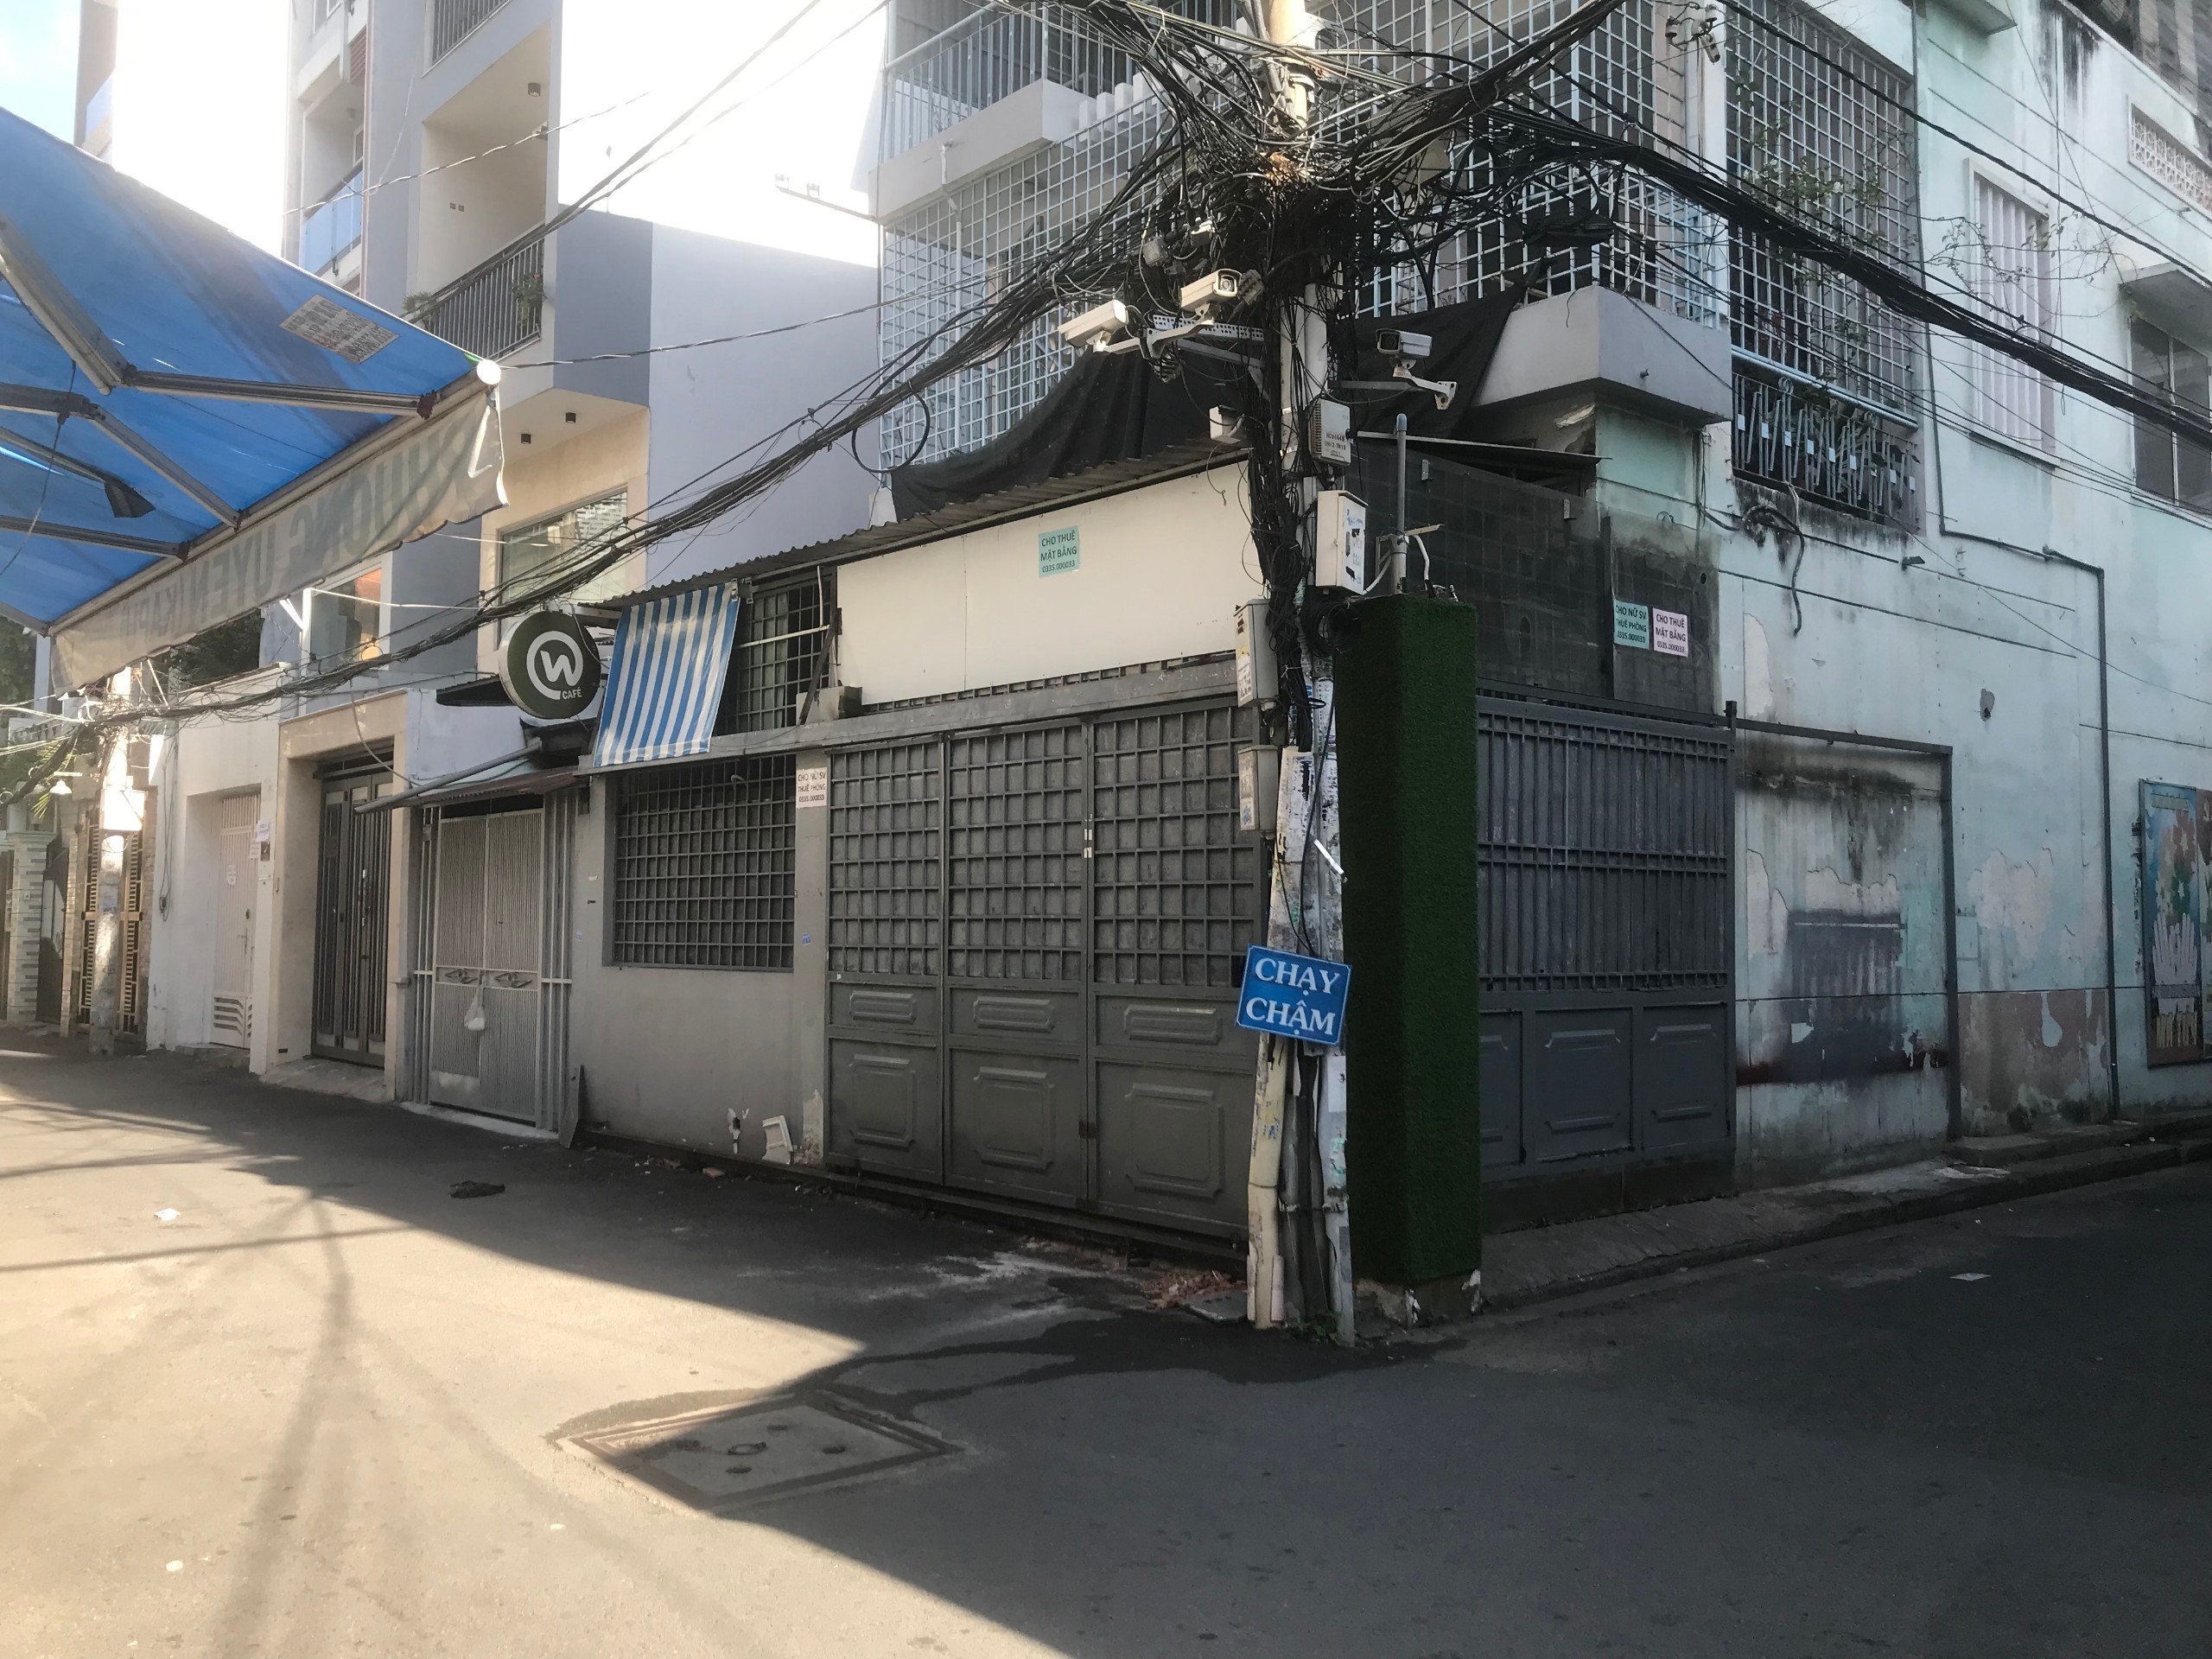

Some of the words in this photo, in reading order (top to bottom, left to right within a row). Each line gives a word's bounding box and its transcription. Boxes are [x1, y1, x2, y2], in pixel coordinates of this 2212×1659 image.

[1041, 536, 1056, 546] CHO
[1057, 530, 1075, 543] THUÊ
[1040, 549, 1056, 562] MẶT
[1615, 605, 1627, 616] CHO
[1638, 610, 1647, 620] SV
[1615, 618, 1628, 628] THUÊ
[1656, 613, 1668, 624] CHO
[1669, 617, 1685, 628] THUÊ
[562, 686, 583, 700] CAFÉ
[1255, 957, 1340, 996] CHẠY
[1246, 996, 1336, 1035] CHẬM
